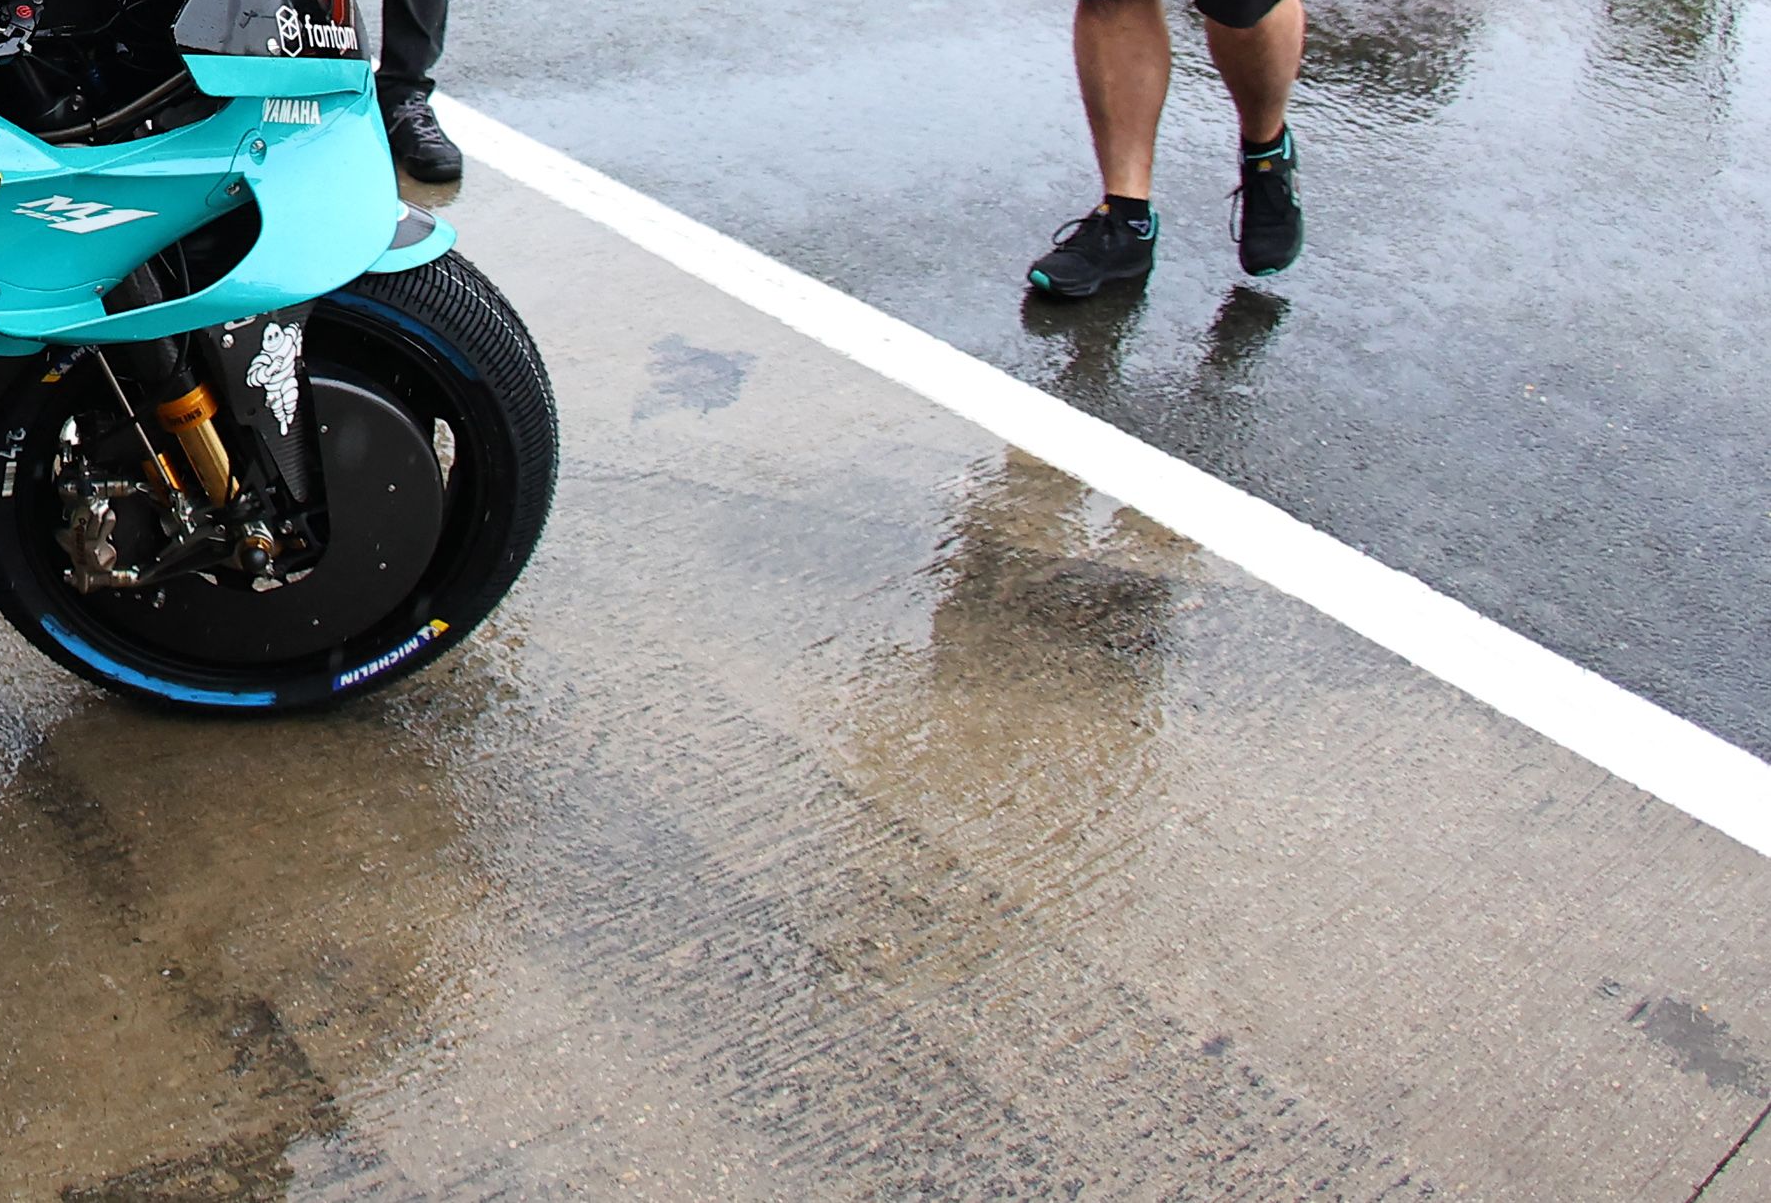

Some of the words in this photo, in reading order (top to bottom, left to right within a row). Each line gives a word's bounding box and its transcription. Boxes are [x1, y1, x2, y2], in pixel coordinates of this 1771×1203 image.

[305, 14, 358, 50] fantom
[263, 99, 321, 125] YAMAHA
[340, 637, 419, 686] MICHELIN
